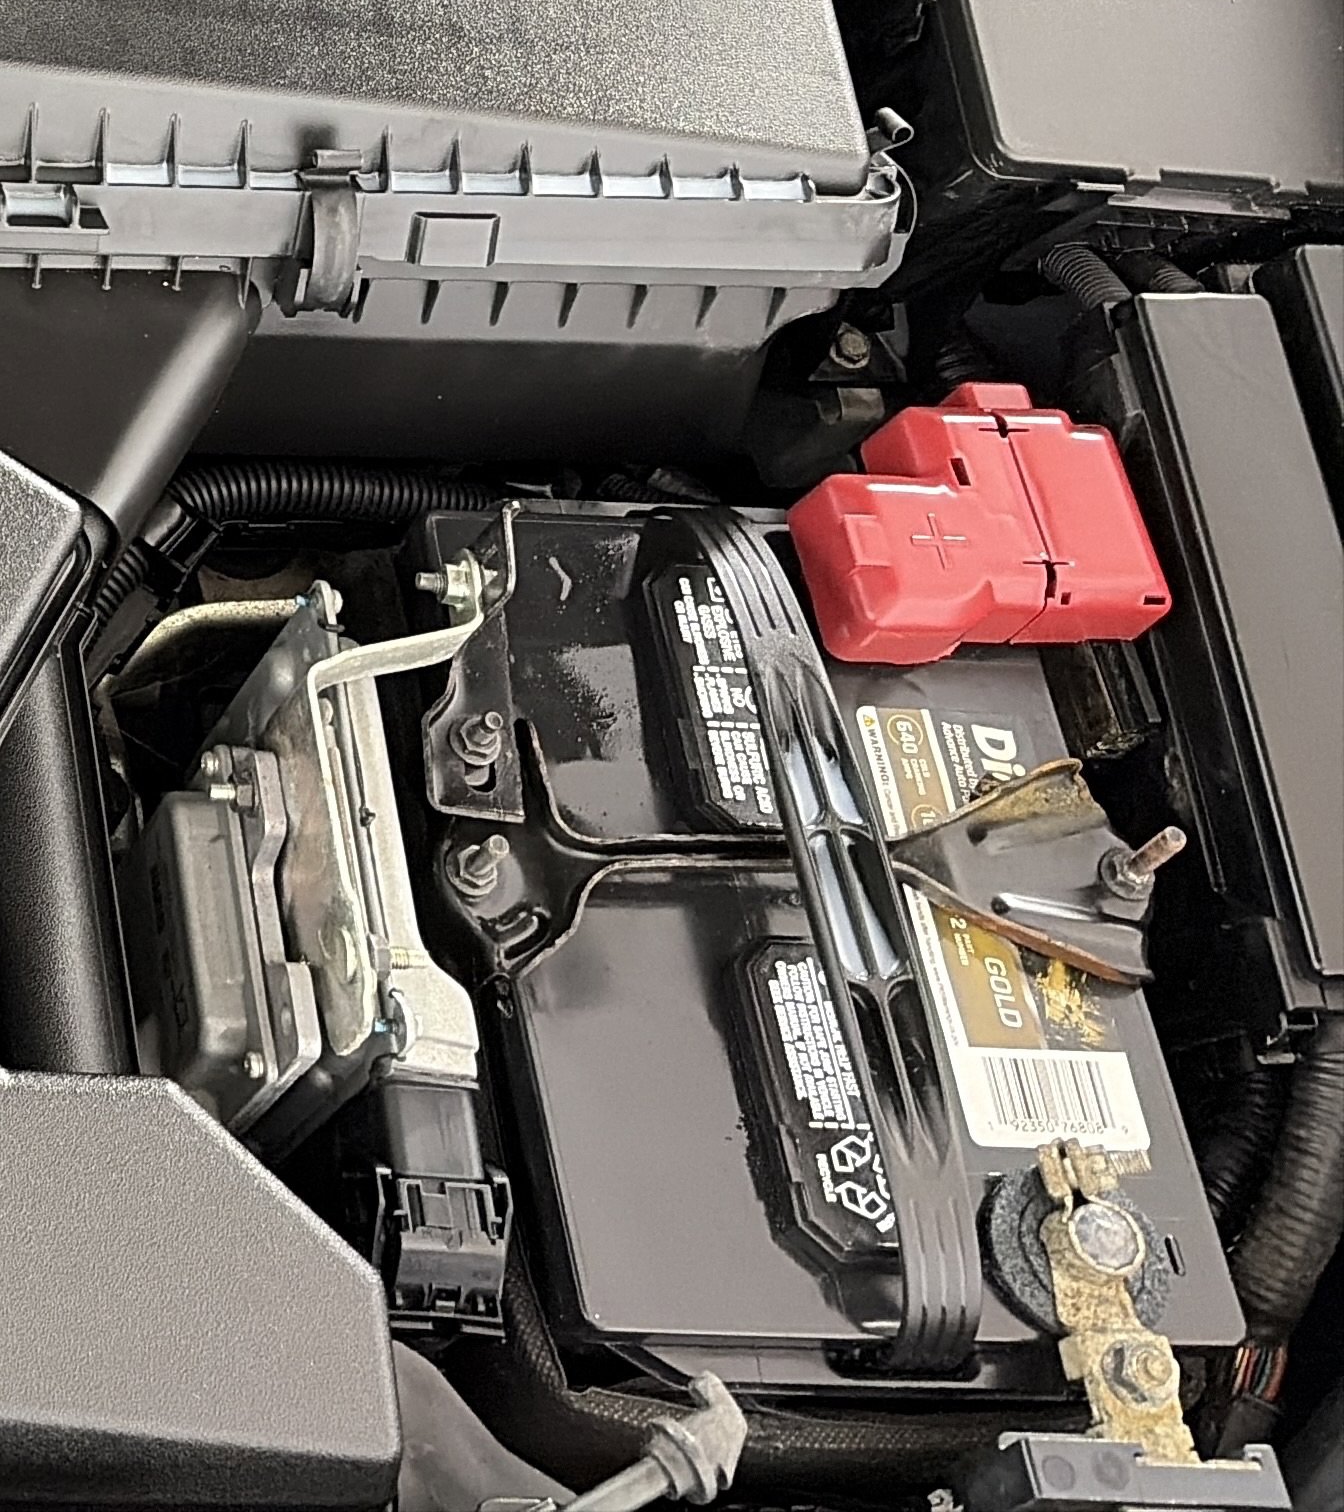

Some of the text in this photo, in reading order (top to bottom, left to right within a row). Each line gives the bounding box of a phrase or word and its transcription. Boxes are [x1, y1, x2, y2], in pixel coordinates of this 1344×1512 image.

[698, 604, 716, 639] GASES
[711, 605, 736, 661] EXPLOSIVE
[729, 687, 746, 708] NO
[731, 730, 744, 752] CAN
[867, 728, 890, 786] WARNING:
[896, 720, 919, 755] 640
[941, 721, 960, 763] Advance
[953, 763, 967, 790] Auto
[952, 724, 978, 777] Distributed
[971, 723, 1027, 782] Di
[719, 730, 746, 801] BLINDNESS OR
[741, 731, 773, 814] SULFURIC ACID
[953, 932, 970, 967] NUMBER
[962, 933, 975, 955] PART
[984, 956, 1023, 1028] GOLD
[842, 1071, 861, 1098] FAST
[1010, 1119, 1055, 1134] 92350
[815, 1153, 837, 1203] RECYCLE
